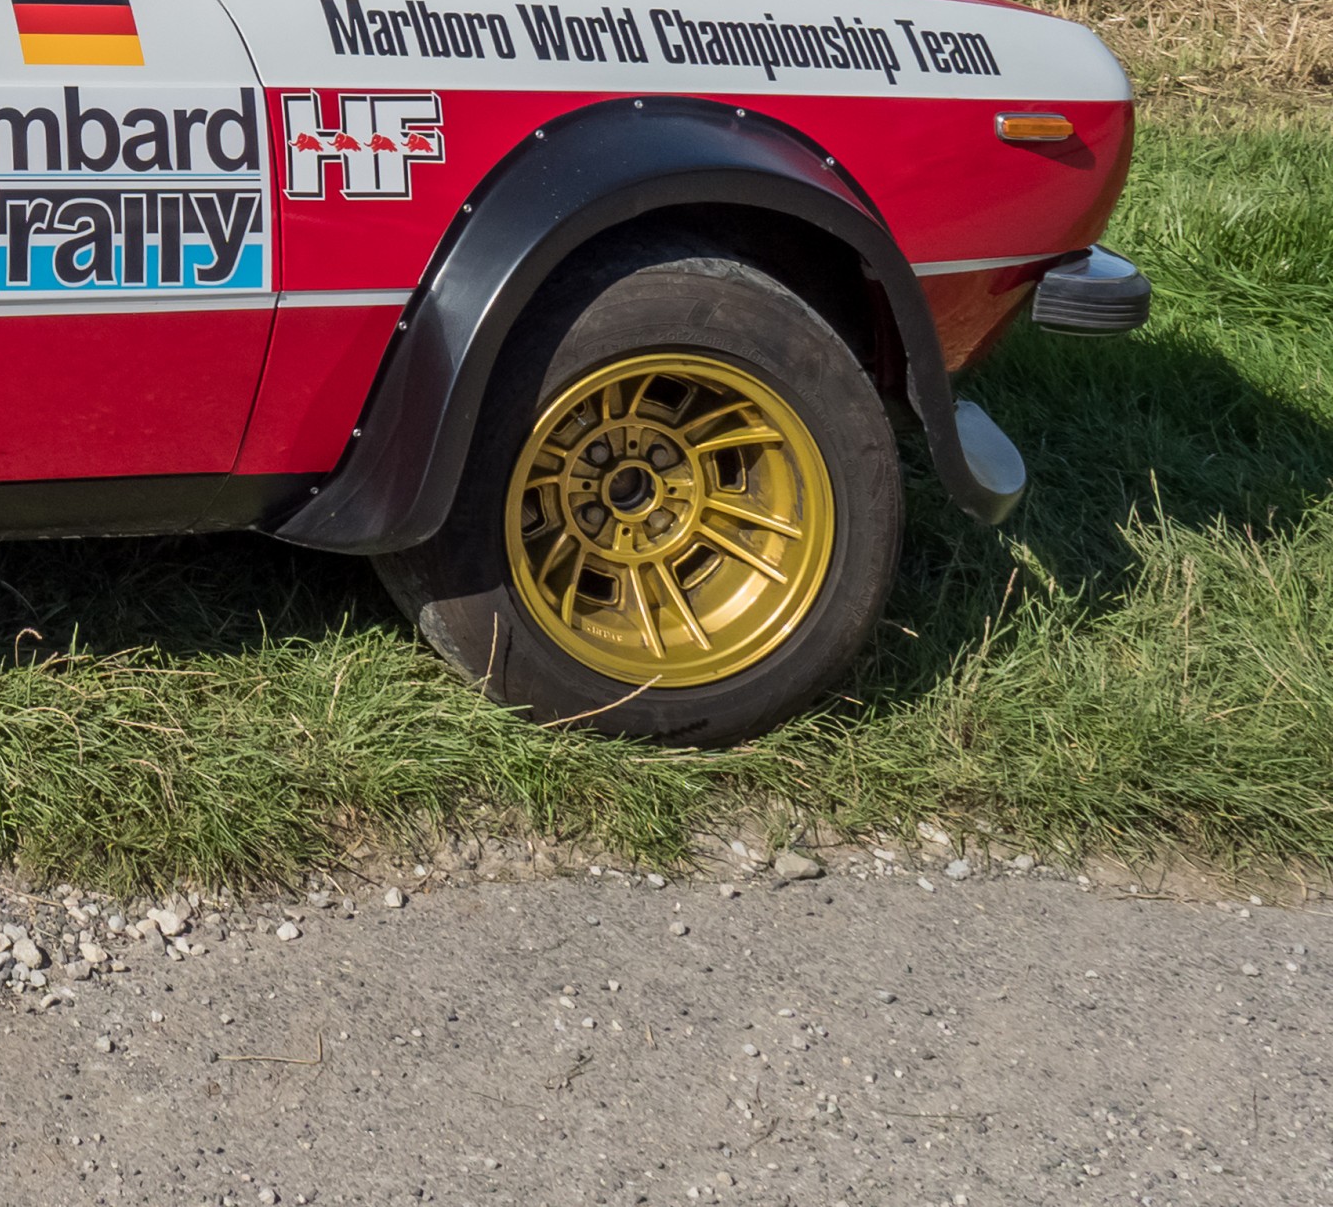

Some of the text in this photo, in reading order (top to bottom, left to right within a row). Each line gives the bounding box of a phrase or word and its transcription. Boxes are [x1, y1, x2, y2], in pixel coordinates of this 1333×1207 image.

[517, 3, 647, 64] World
[648, 8, 898, 85] Championship
[895, 18, 1001, 77] Team
[281, 90, 445, 201] HF
[6, 192, 264, 287] rally
